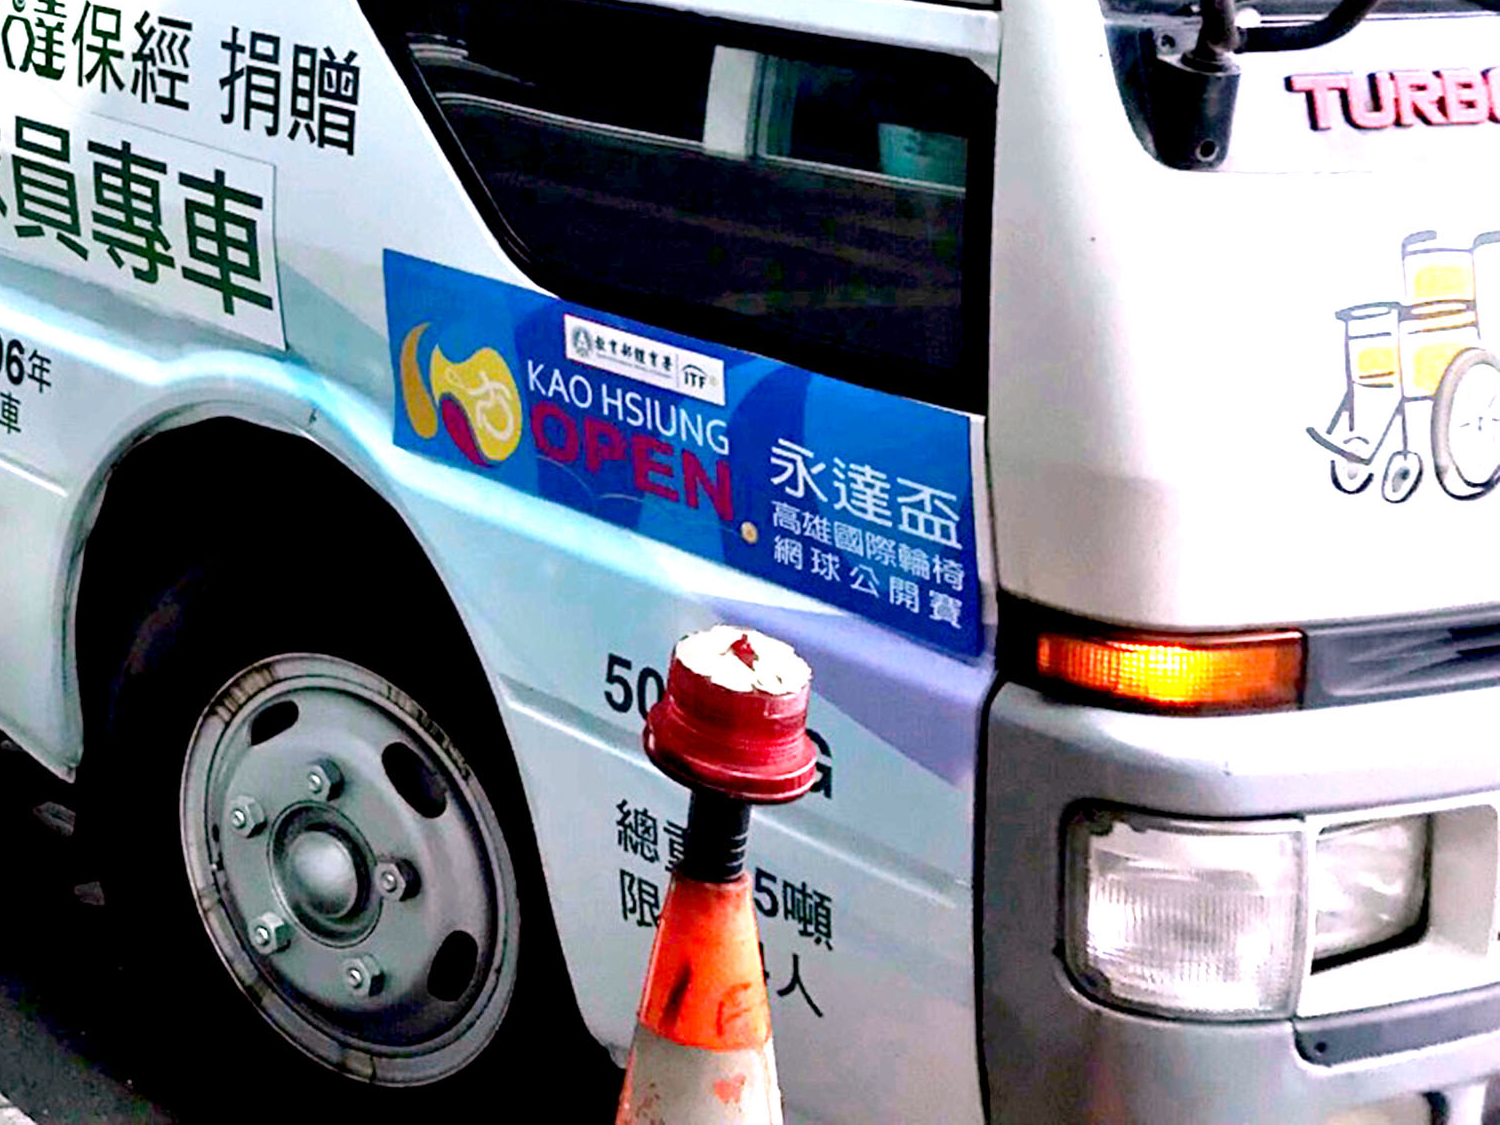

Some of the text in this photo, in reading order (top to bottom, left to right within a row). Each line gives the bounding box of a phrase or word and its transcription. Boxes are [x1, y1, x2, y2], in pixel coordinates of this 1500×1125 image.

[219, 25, 362, 156] 捐贈
[1284, 68, 1500, 131] TURB
[527, 359, 593, 409] KAO
[601, 383, 730, 456] HSIUNG
[530, 400, 735, 522] OPEN
[770, 437, 963, 550] 永達盃
[771, 500, 966, 593] 高雄國際輪椅
[773, 535, 963, 630] 網球公開賽
